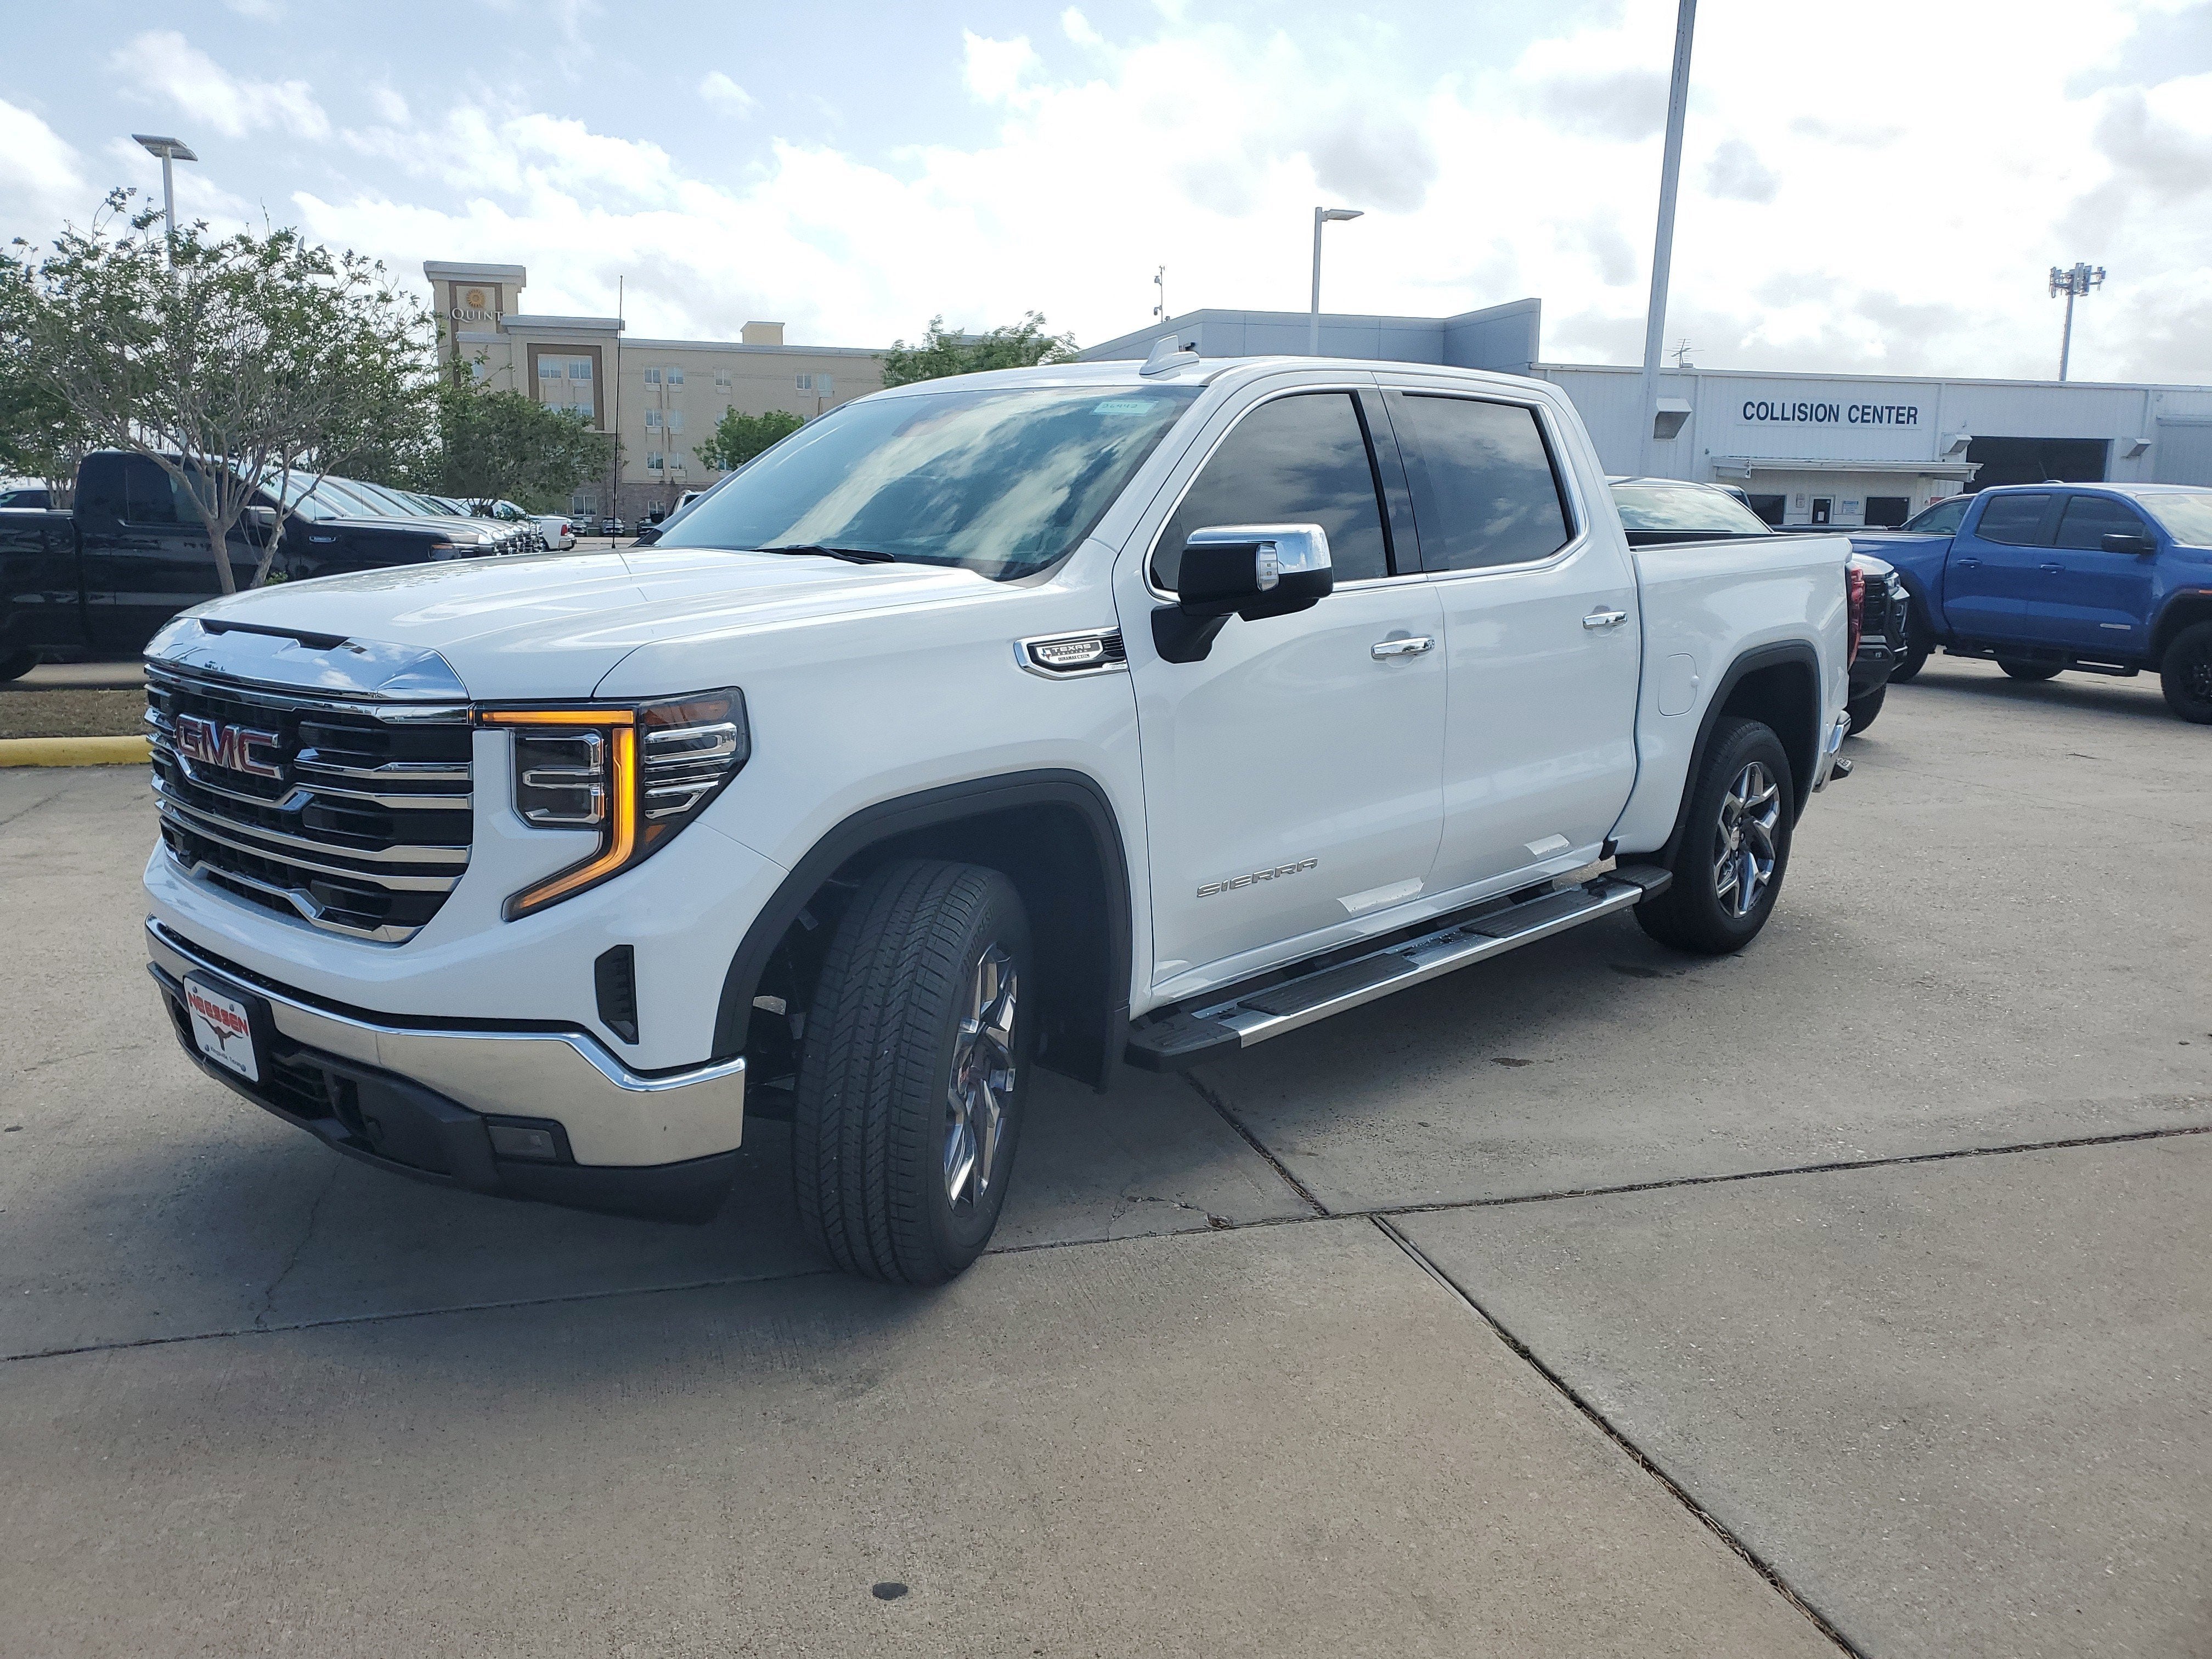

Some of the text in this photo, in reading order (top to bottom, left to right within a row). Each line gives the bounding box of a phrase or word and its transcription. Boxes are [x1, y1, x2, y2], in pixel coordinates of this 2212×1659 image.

[452, 307, 503, 323] QUINT
[1743, 401, 1918, 425] COLLISION CENTER
[1051, 644, 1092, 653] TEXAS
[176, 713, 284, 781] GMC
[1197, 857, 1318, 898] SIERRA
[188, 991, 249, 1037] NEESSEN
